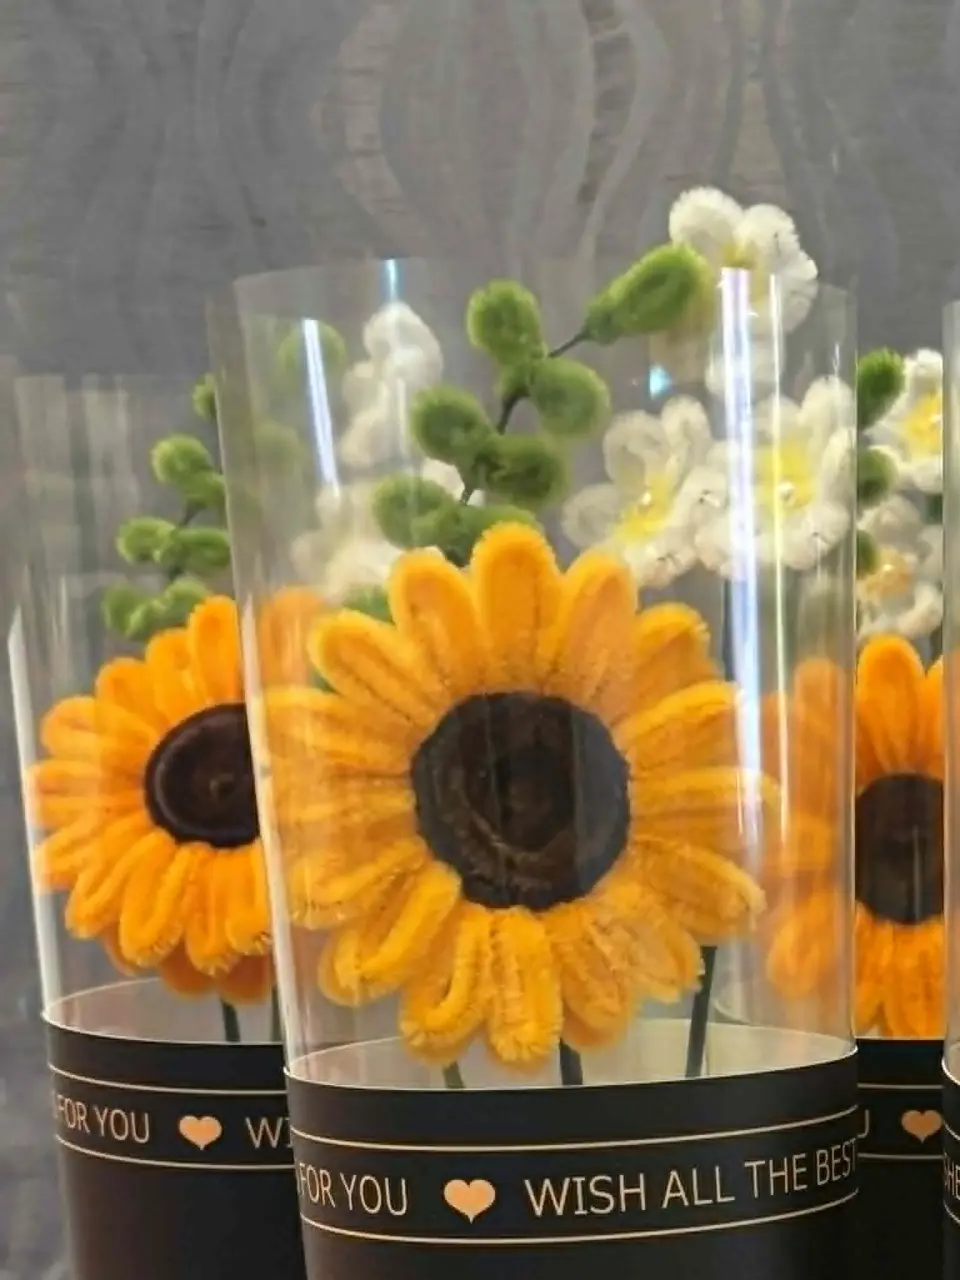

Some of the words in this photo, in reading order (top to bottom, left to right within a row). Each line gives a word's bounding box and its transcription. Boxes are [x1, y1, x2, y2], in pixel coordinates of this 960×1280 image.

[93, 1105, 150, 1144] YOU
[299, 1161, 336, 1208] FOR
[340, 1172, 409, 1216] YOU
[524, 1172, 647, 1218] WISH
[661, 1165, 736, 1209] ALL
[744, 1152, 808, 1199] THE
[815, 1138, 858, 1186] BEST
